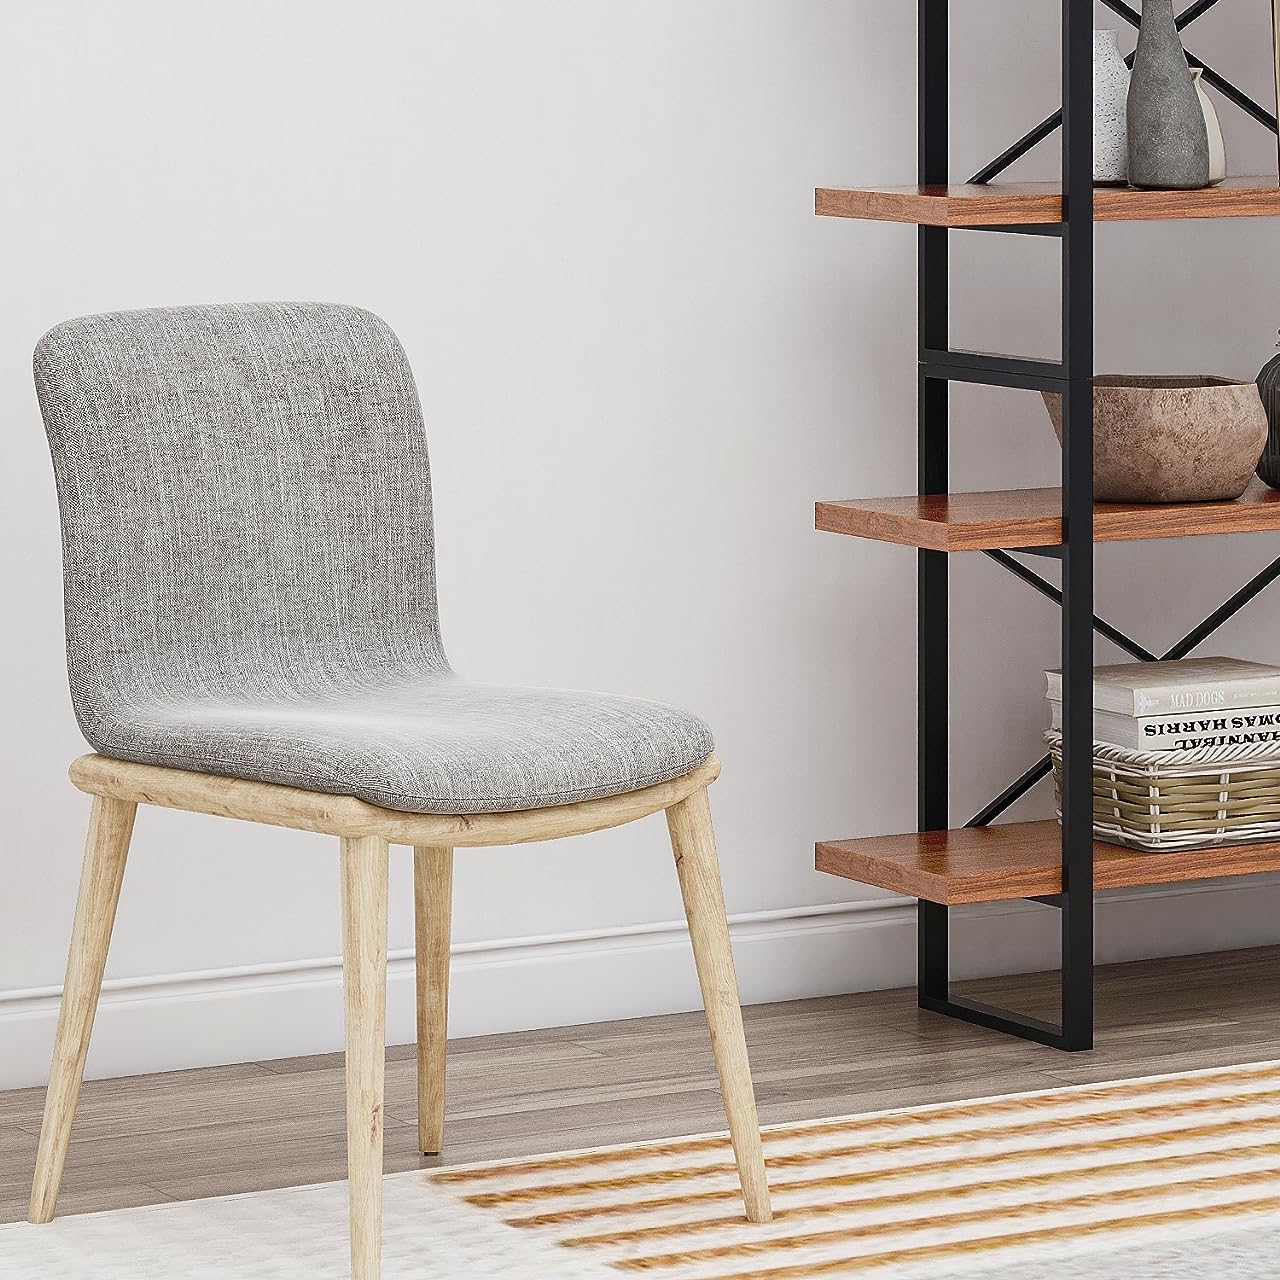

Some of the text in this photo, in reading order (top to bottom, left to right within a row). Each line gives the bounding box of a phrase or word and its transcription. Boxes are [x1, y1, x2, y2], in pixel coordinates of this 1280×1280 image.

[1170, 692, 1195, 708] MAD
[1196, 690, 1225, 707] DOGS
[1144, 718, 1227, 737] HARRIS
